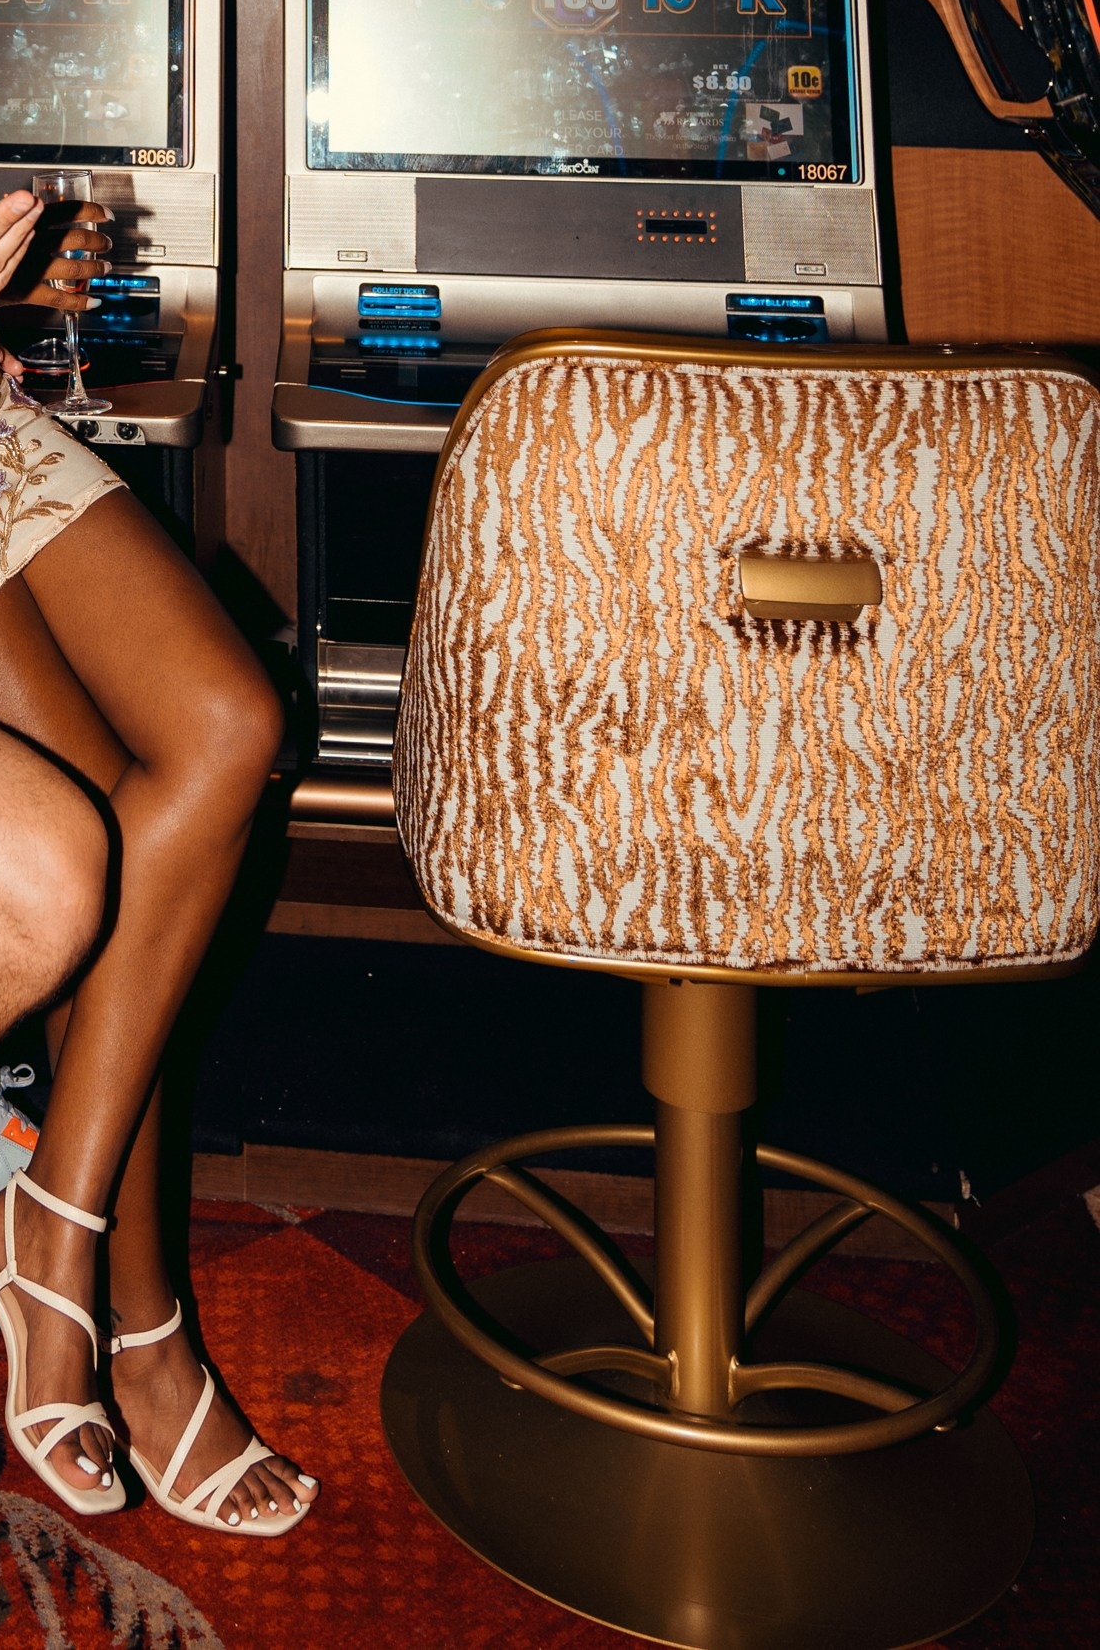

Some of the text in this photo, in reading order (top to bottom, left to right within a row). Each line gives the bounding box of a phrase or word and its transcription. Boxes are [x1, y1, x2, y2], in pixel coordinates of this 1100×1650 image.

[584, 127, 622, 139] YOUR
[586, 144, 624, 156] CARD
[128, 149, 177, 166] 18066
[798, 164, 848, 182] 18067
[372, 287, 402, 295] COLLECT
[740, 298, 765, 307] INSERT
[765, 299, 781, 307] BILL
[786, 300, 811, 308] TICKET
